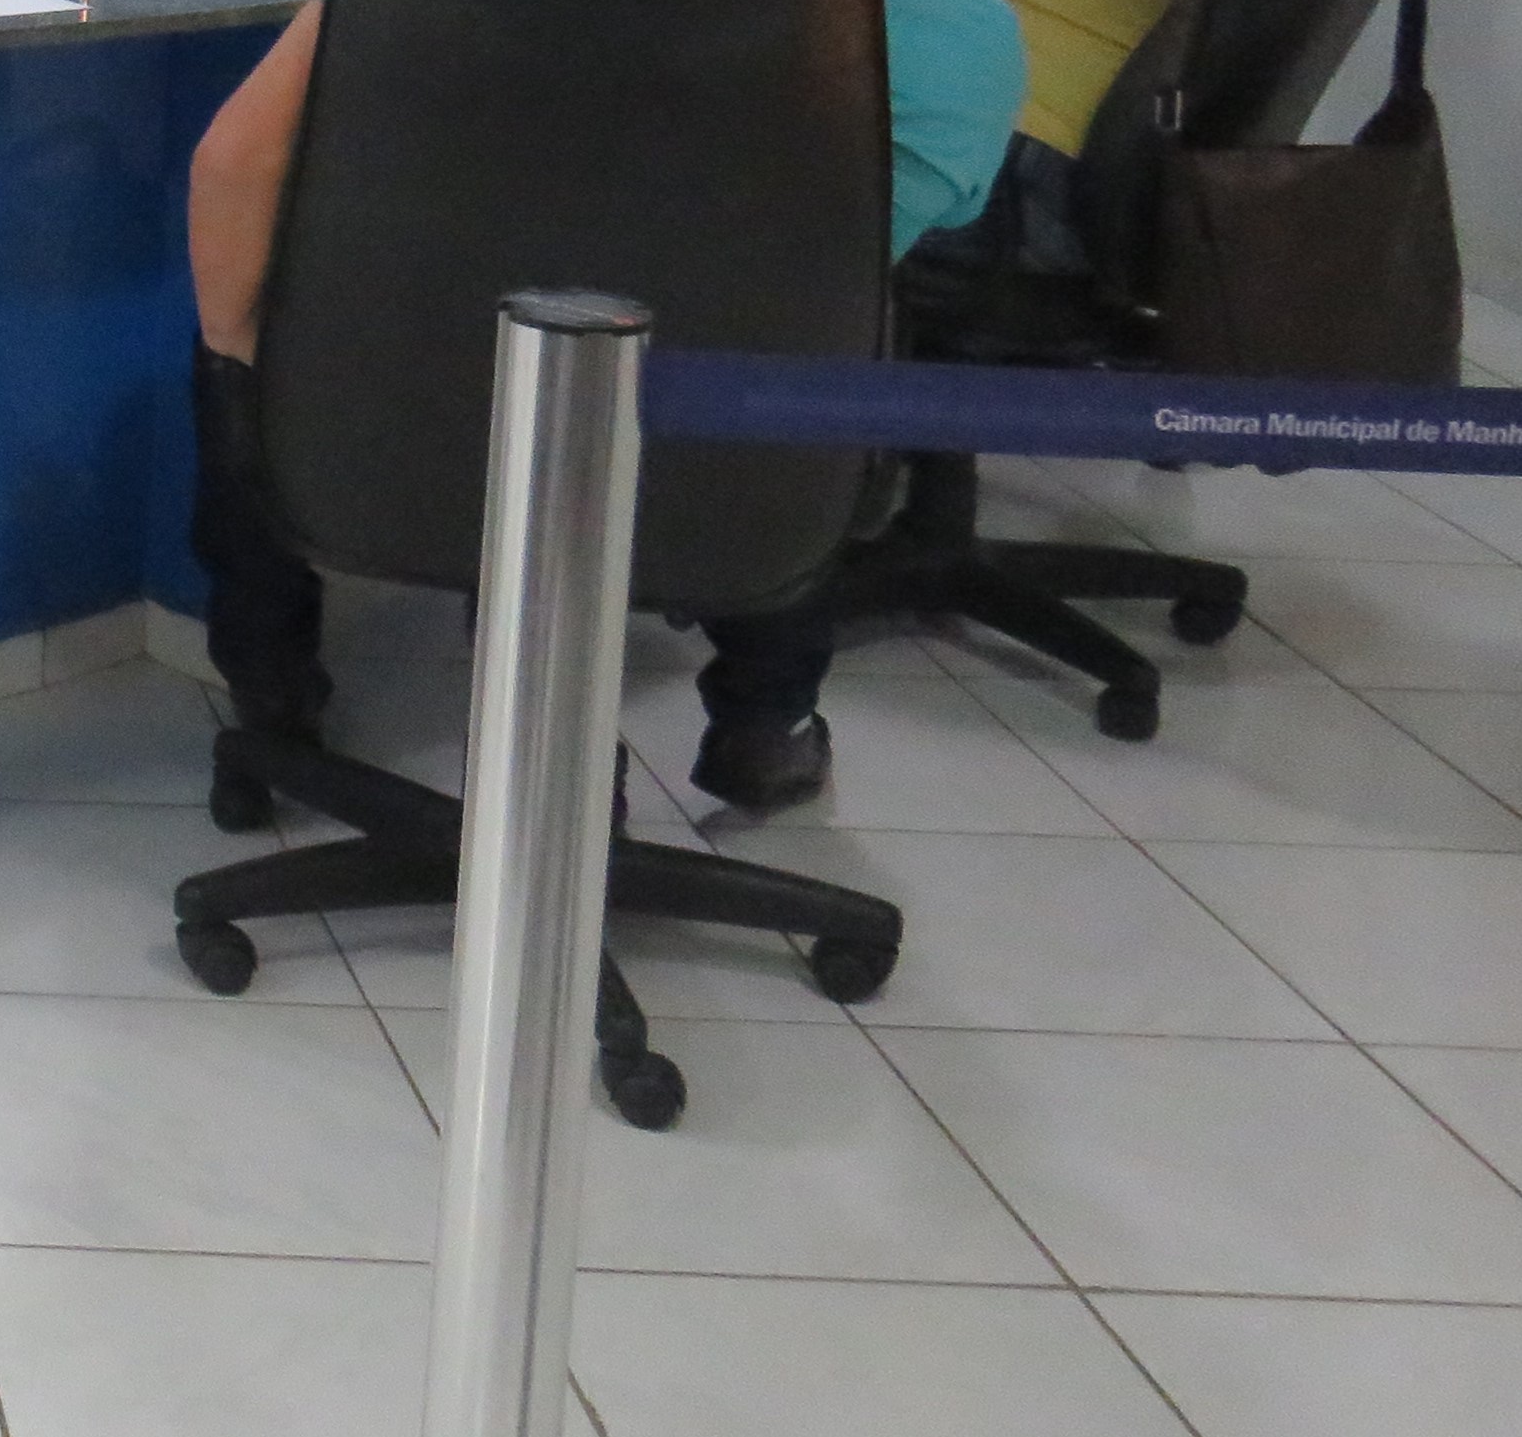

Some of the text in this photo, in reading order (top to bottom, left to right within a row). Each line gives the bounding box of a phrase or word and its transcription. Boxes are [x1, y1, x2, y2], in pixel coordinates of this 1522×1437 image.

[1155, 407, 1259, 434] Câmara
[1267, 412, 1400, 443] Municipal
[1406, 419, 1440, 443] de
